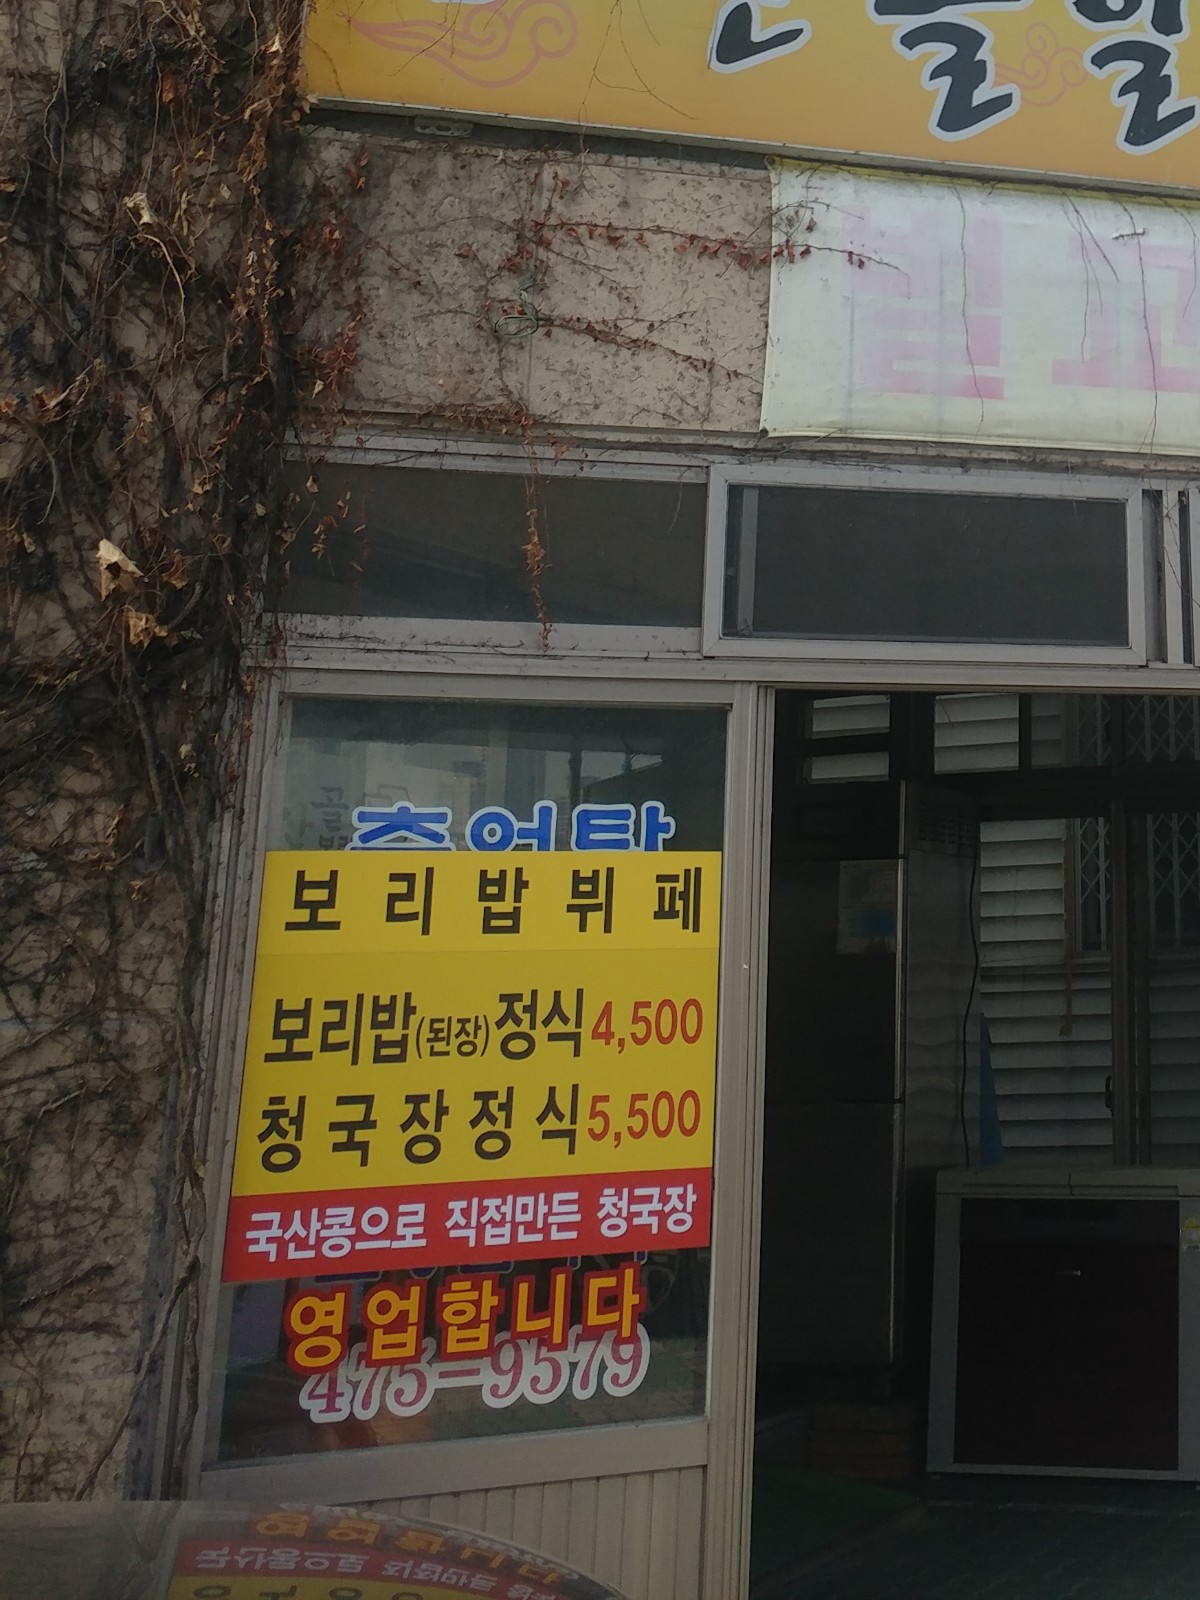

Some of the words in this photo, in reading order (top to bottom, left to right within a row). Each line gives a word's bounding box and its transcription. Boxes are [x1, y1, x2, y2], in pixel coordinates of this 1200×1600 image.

[591, 998, 702, 1055] 4,500
[258, 1083, 580, 1173] 청국장정식
[587, 1089, 701, 1150] 5,500
[245, 1203, 428, 1263] 국산콩으로
[445, 1190, 582, 1248] 직접만든
[597, 1183, 698, 1239] 청국장
[286, 1266, 643, 1371] 영업합니다
[302, 1330, 647, 1419] 475-9579
